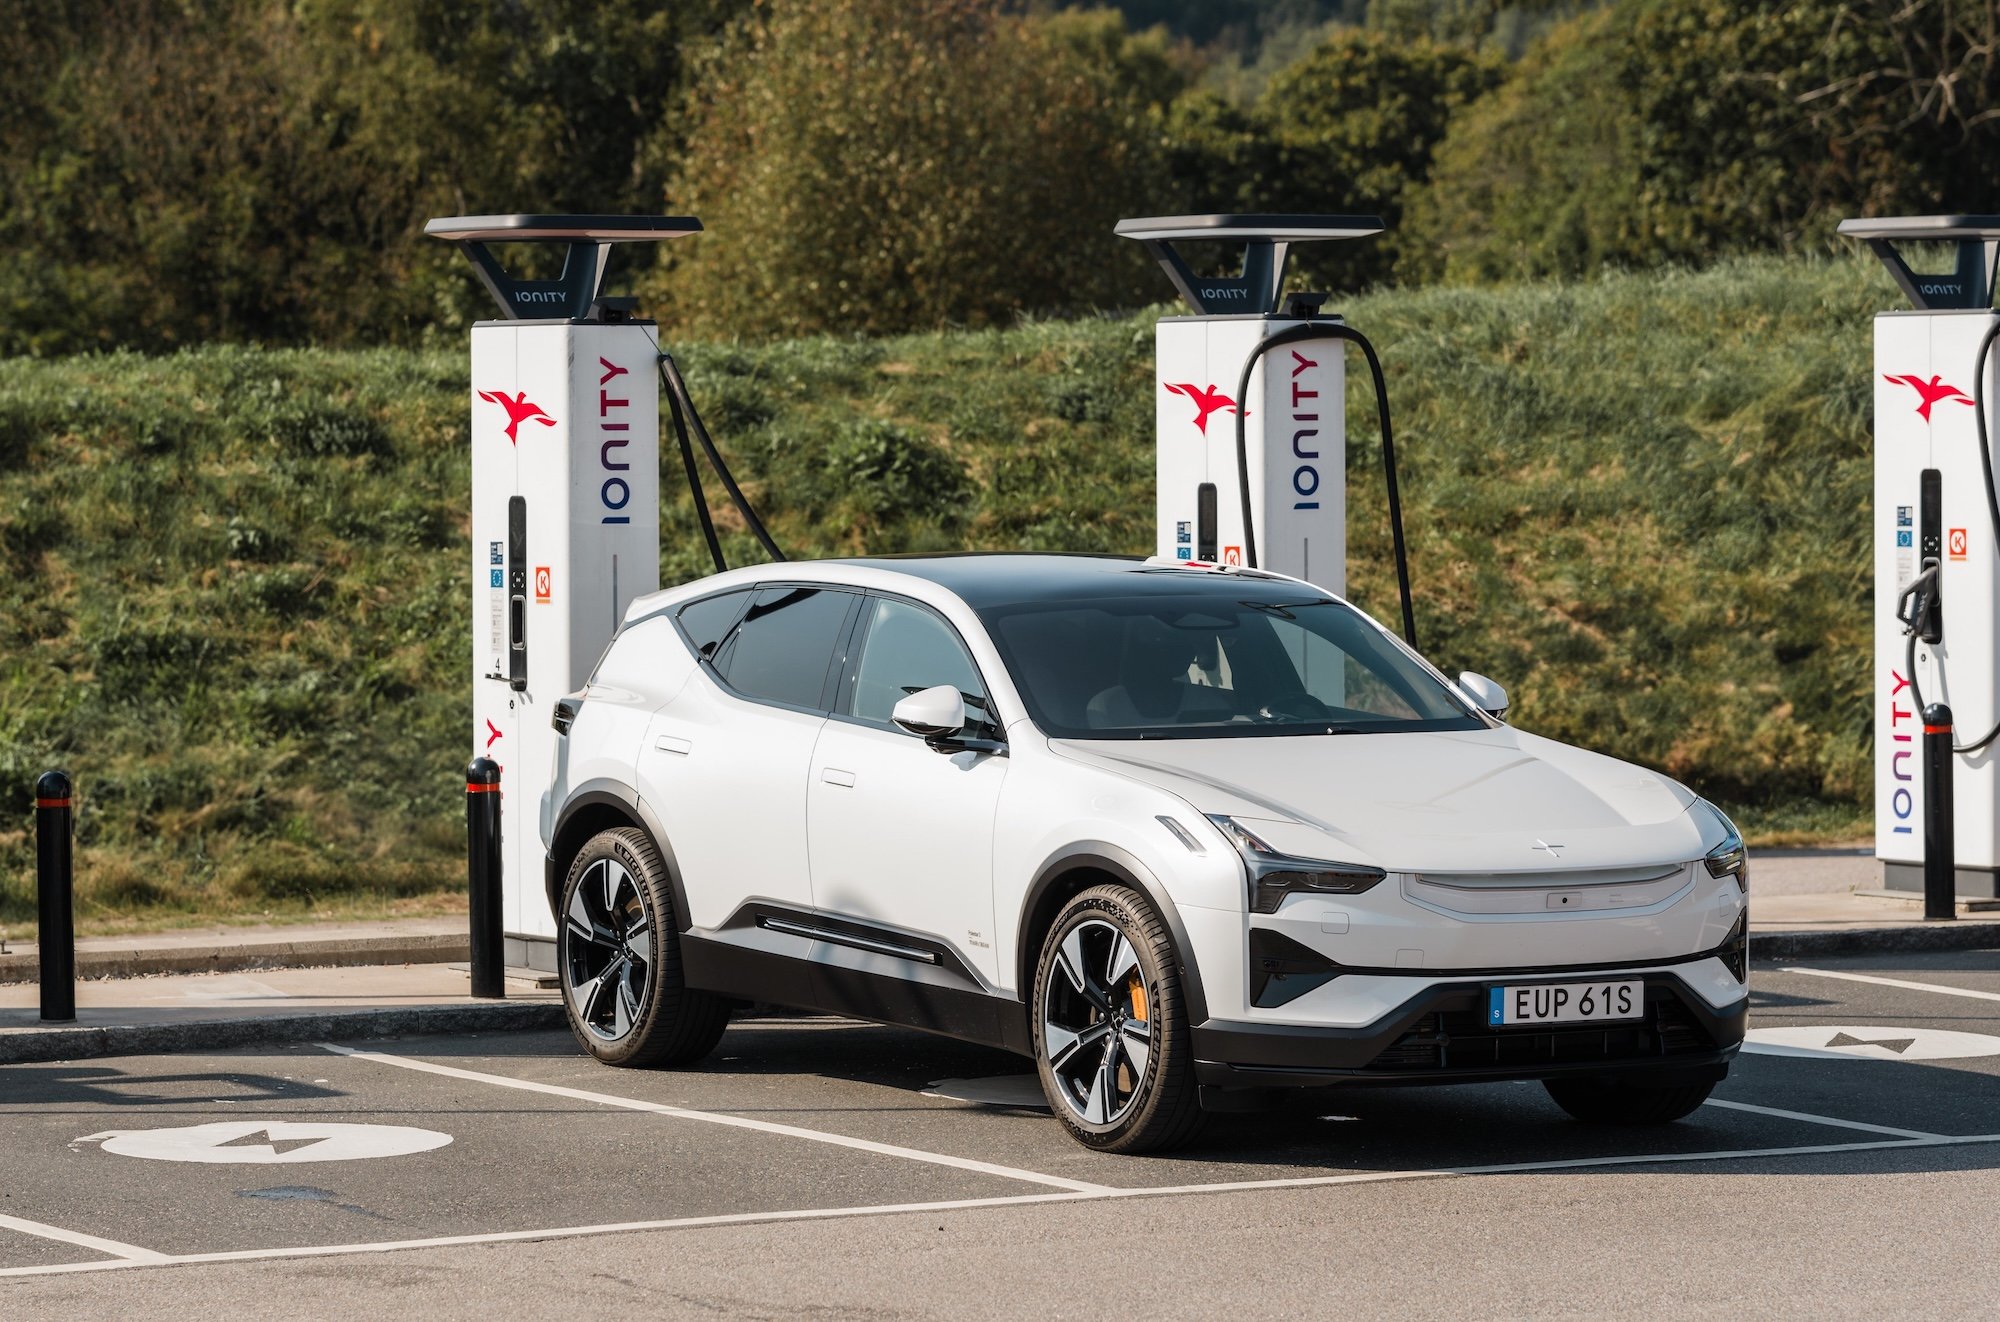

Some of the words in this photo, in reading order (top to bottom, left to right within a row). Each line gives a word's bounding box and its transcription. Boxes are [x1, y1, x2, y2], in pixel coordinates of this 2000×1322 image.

[515, 291, 567, 303] IONITY
[1201, 288, 1248, 300] IONITY
[1920, 284, 1962, 295] IONITY
[600, 356, 630, 524] IONITY
[1292, 350, 1319, 510] IONITY
[495, 657, 501, 671] 4
[1892, 669, 1912, 834] IONITY
[622, 851, 653, 905] MICHELIN
[1494, 1009, 1501, 1018] S
[1516, 989, 1569, 1019] EUP
[1578, 985, 1632, 1016] 61S
